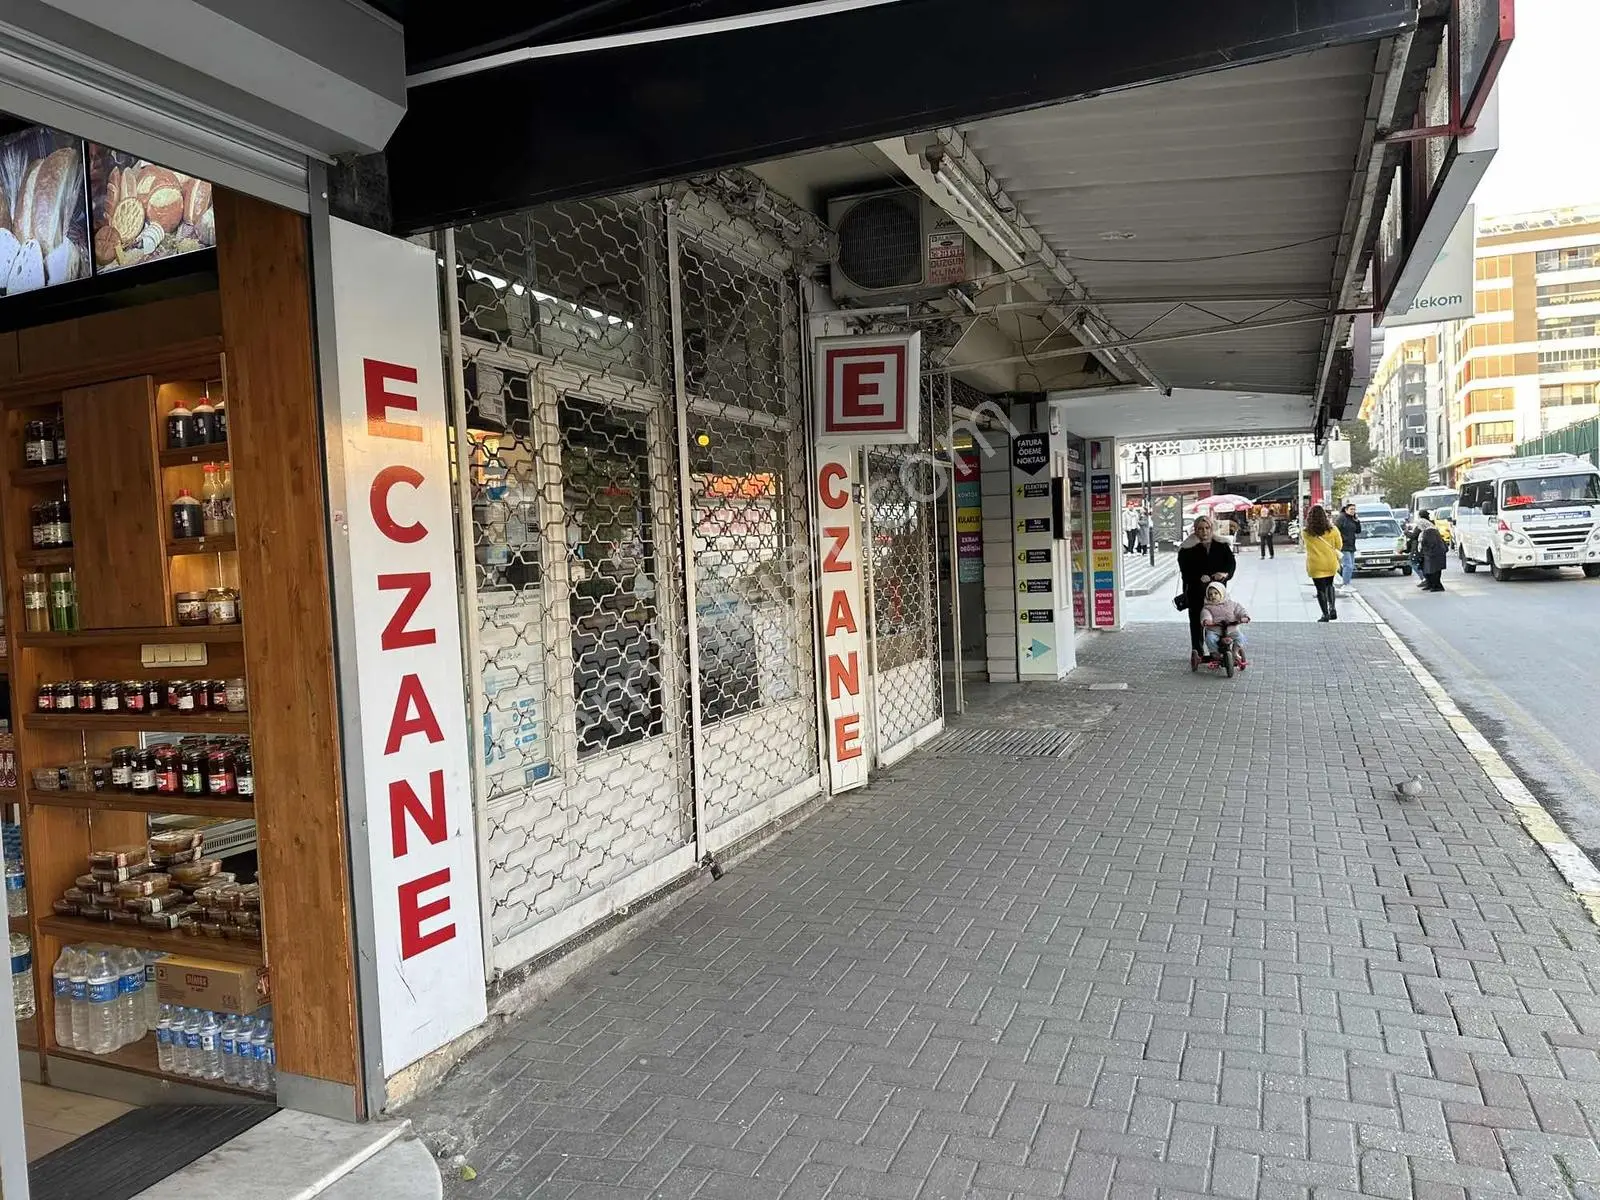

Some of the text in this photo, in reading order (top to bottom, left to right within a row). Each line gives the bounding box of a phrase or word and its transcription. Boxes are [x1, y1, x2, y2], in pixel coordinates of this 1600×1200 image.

[843, 361, 885, 417] E
[1017, 438, 1043, 447] FATURA
[1018, 446, 1042, 456] ÖDEME
[1016, 456, 1046, 465] NOKTASI
[818, 462, 862, 762] CZANE
[363, 358, 456, 961] ECZANE
